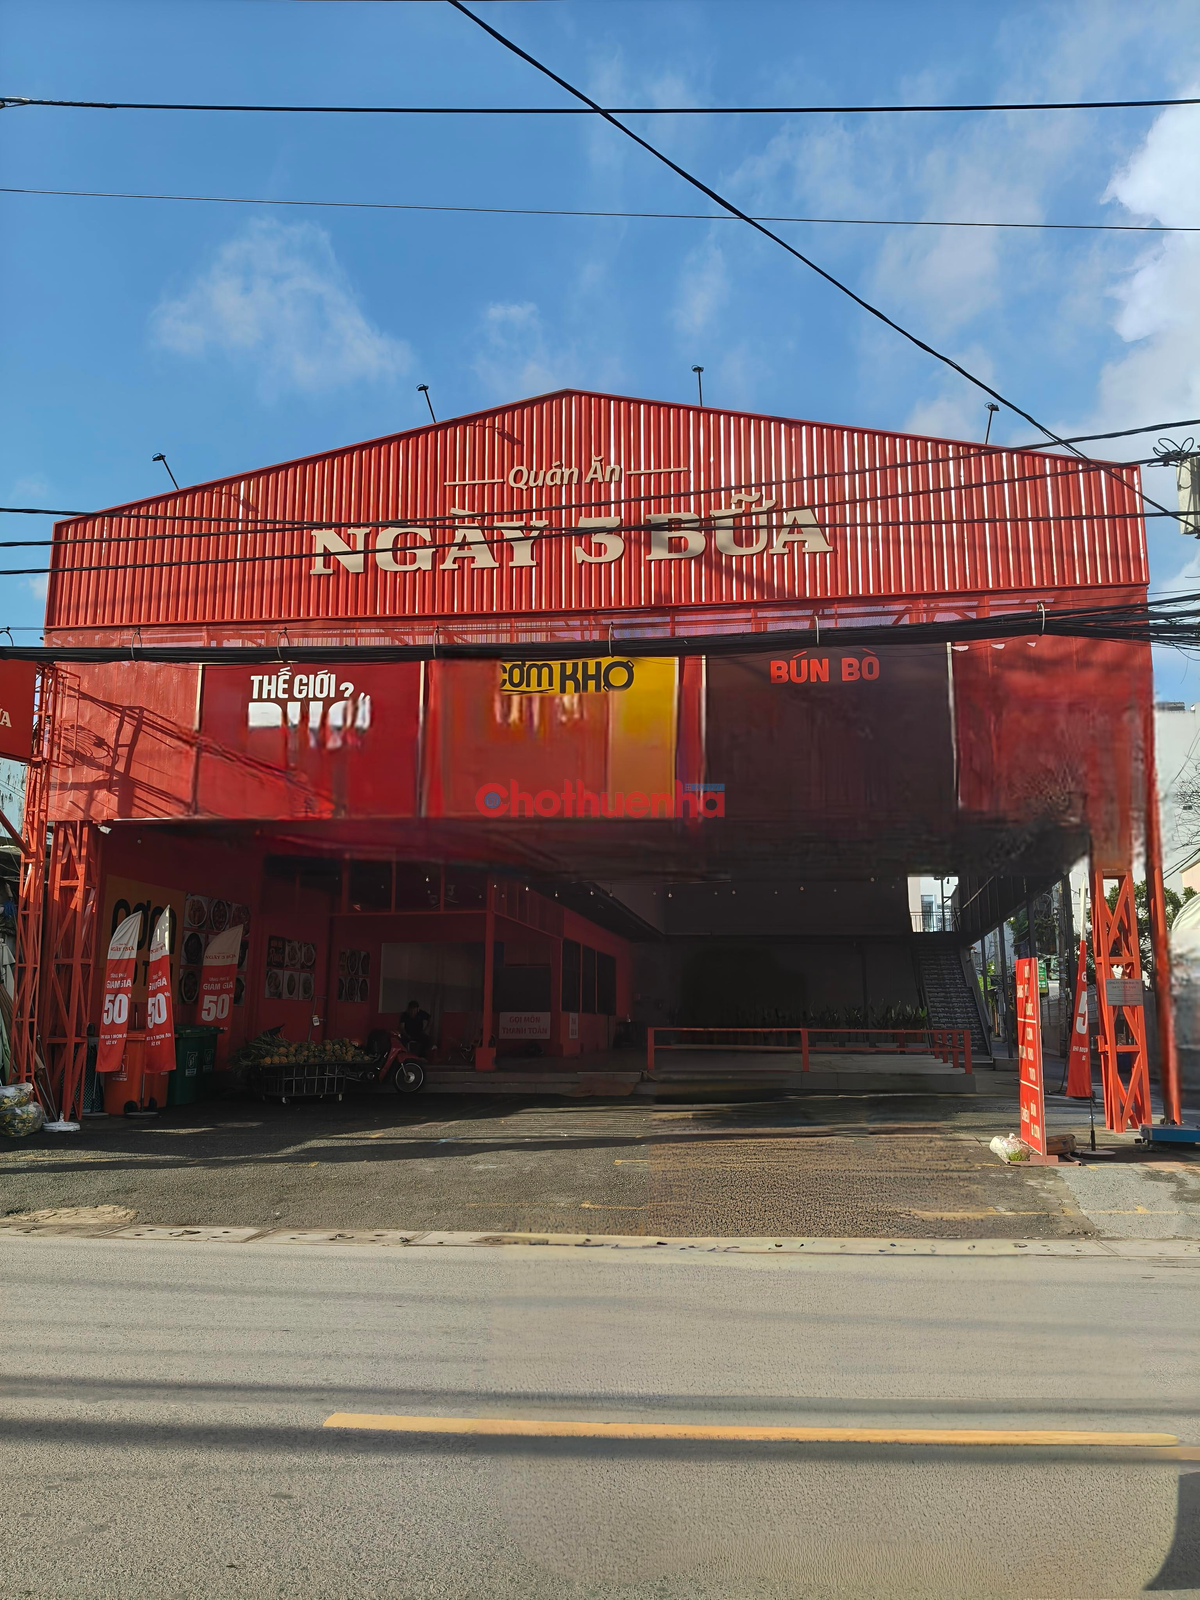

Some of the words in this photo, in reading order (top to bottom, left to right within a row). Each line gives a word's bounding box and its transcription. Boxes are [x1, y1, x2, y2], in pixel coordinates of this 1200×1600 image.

[507, 462, 578, 490] Quán
[584, 456, 621, 484] Ăn
[310, 508, 549, 575] NGÀY
[574, 516, 623, 564] 5
[644, 492, 834, 561] BỮA
[250, 667, 292, 699] THẾ
[293, 669, 336, 699] GIỚI
[770, 651, 829, 684] BÚN
[841, 648, 880, 682] BÒ
